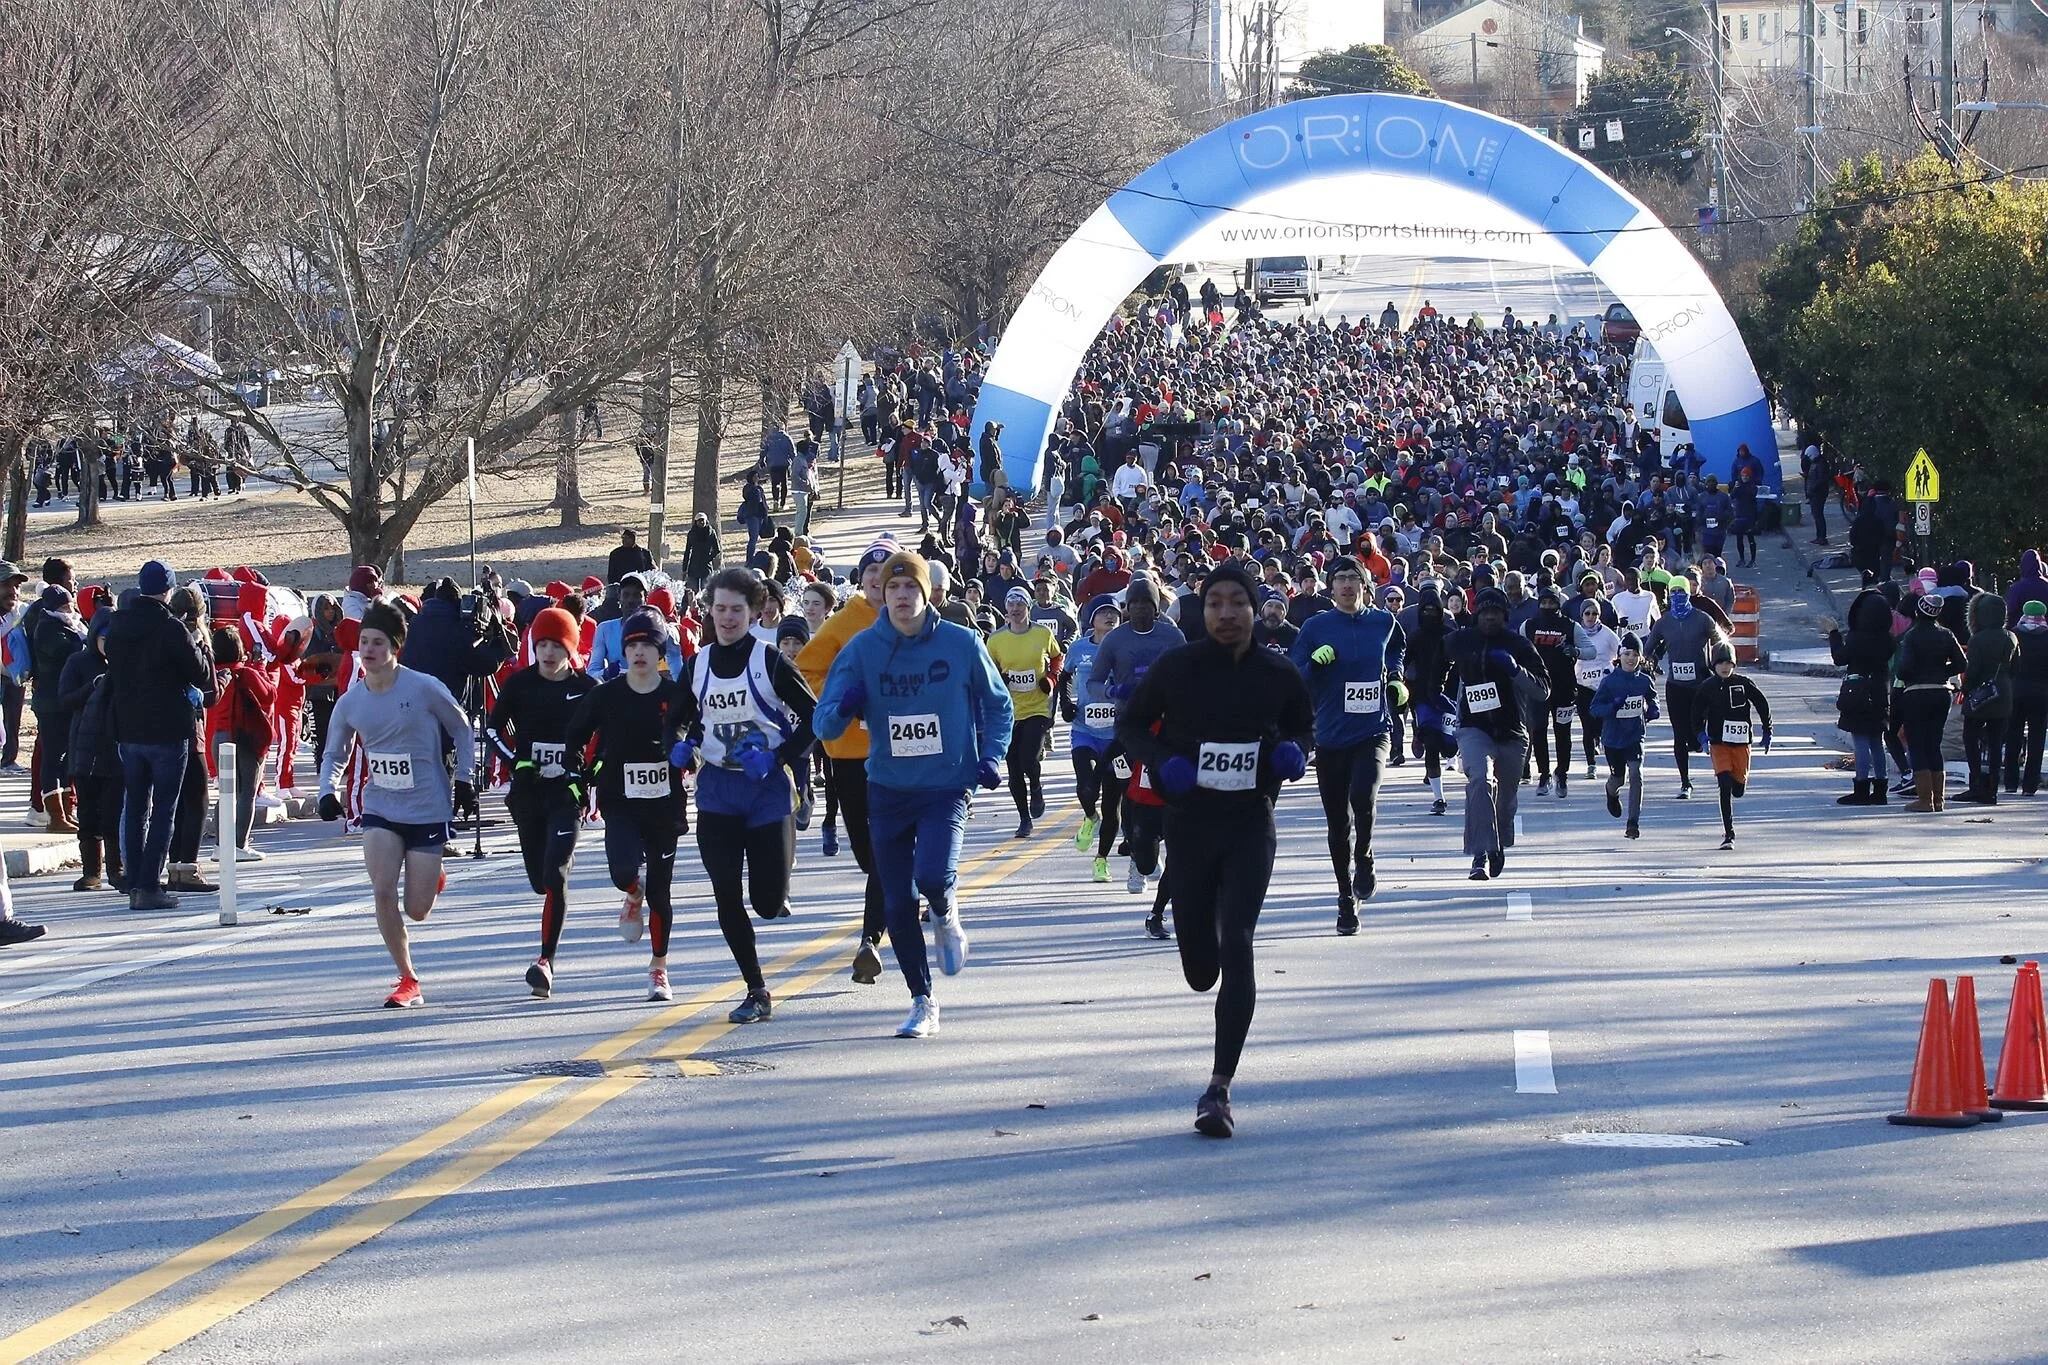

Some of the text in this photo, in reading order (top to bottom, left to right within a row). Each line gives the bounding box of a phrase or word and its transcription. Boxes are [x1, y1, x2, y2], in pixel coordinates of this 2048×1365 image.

[1221, 222, 1532, 245] www.orionsportstiming.com
[1009, 672, 1036, 685] 4303
[1582, 669, 1602, 680] 2457
[1673, 665, 1695, 675] 3152
[879, 673, 925, 685] PLAIN
[708, 689, 747, 710] 4347
[1346, 686, 1380, 701] 2458
[1466, 686, 1497, 704] 2899
[1086, 707, 1116, 720] 2686
[891, 721, 939, 742] 2464
[1724, 724, 1748, 736] 1533
[533, 748, 564, 765] 150
[1201, 750, 1256, 772] 2645
[370, 759, 411, 776] 2158
[626, 766, 668, 786] 1506
